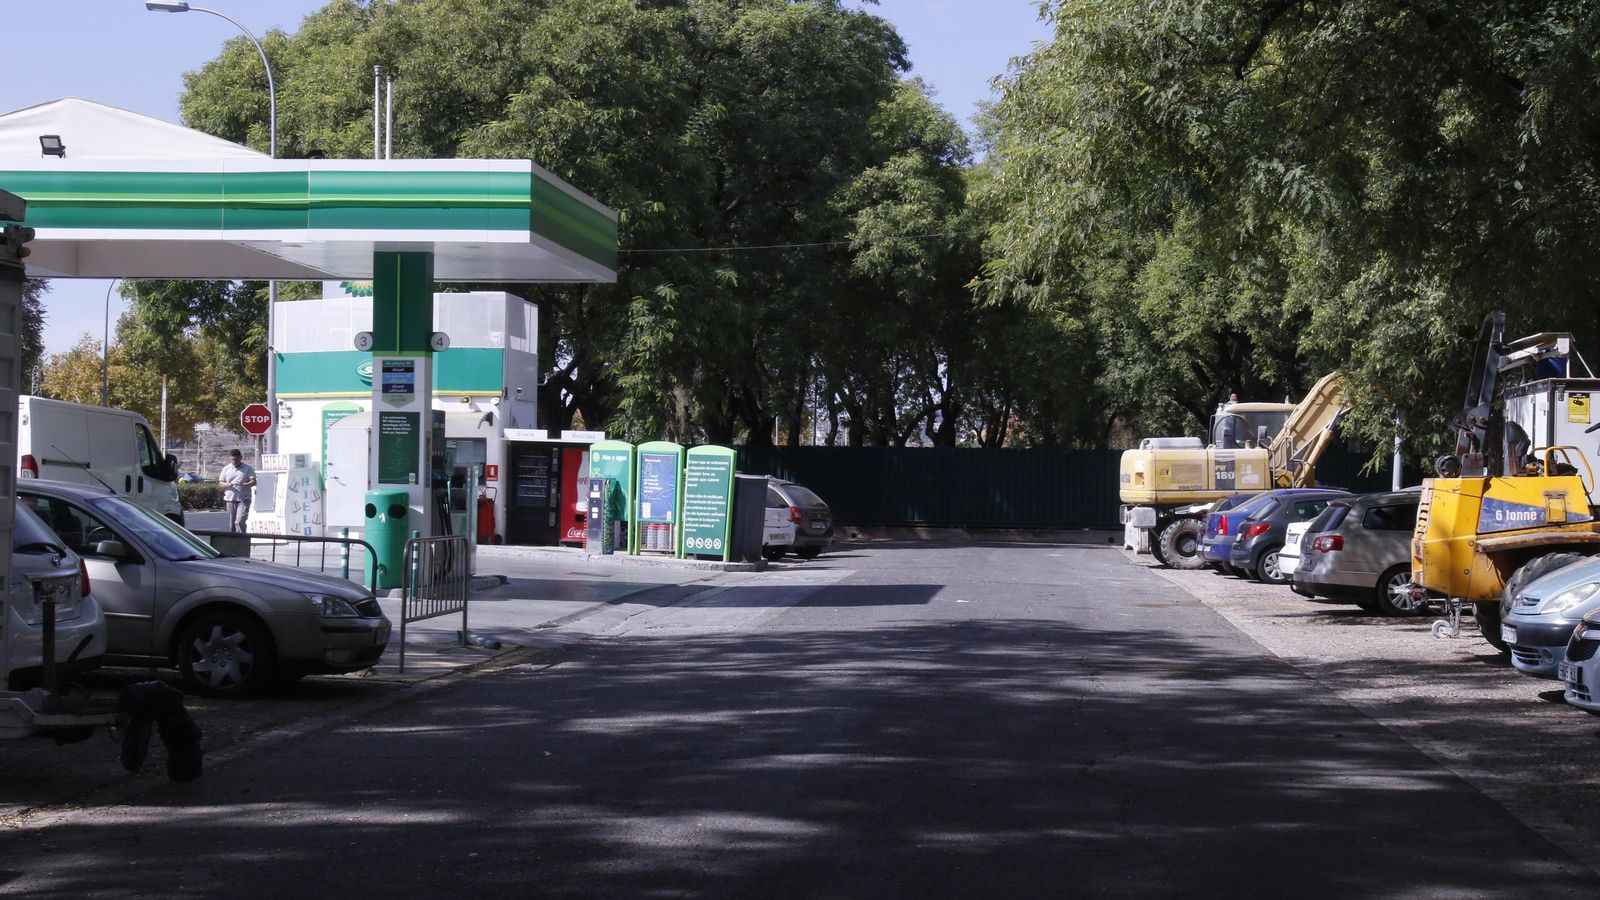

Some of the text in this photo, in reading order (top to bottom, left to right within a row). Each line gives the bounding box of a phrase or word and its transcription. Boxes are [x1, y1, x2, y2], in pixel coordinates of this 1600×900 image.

[360, 336, 368, 347] 3
[436, 336, 444, 347] 4
[244, 415, 270, 424] STOP
[264, 455, 288, 470] HIELO
[1495, 508, 1537, 521] 6 tonne
